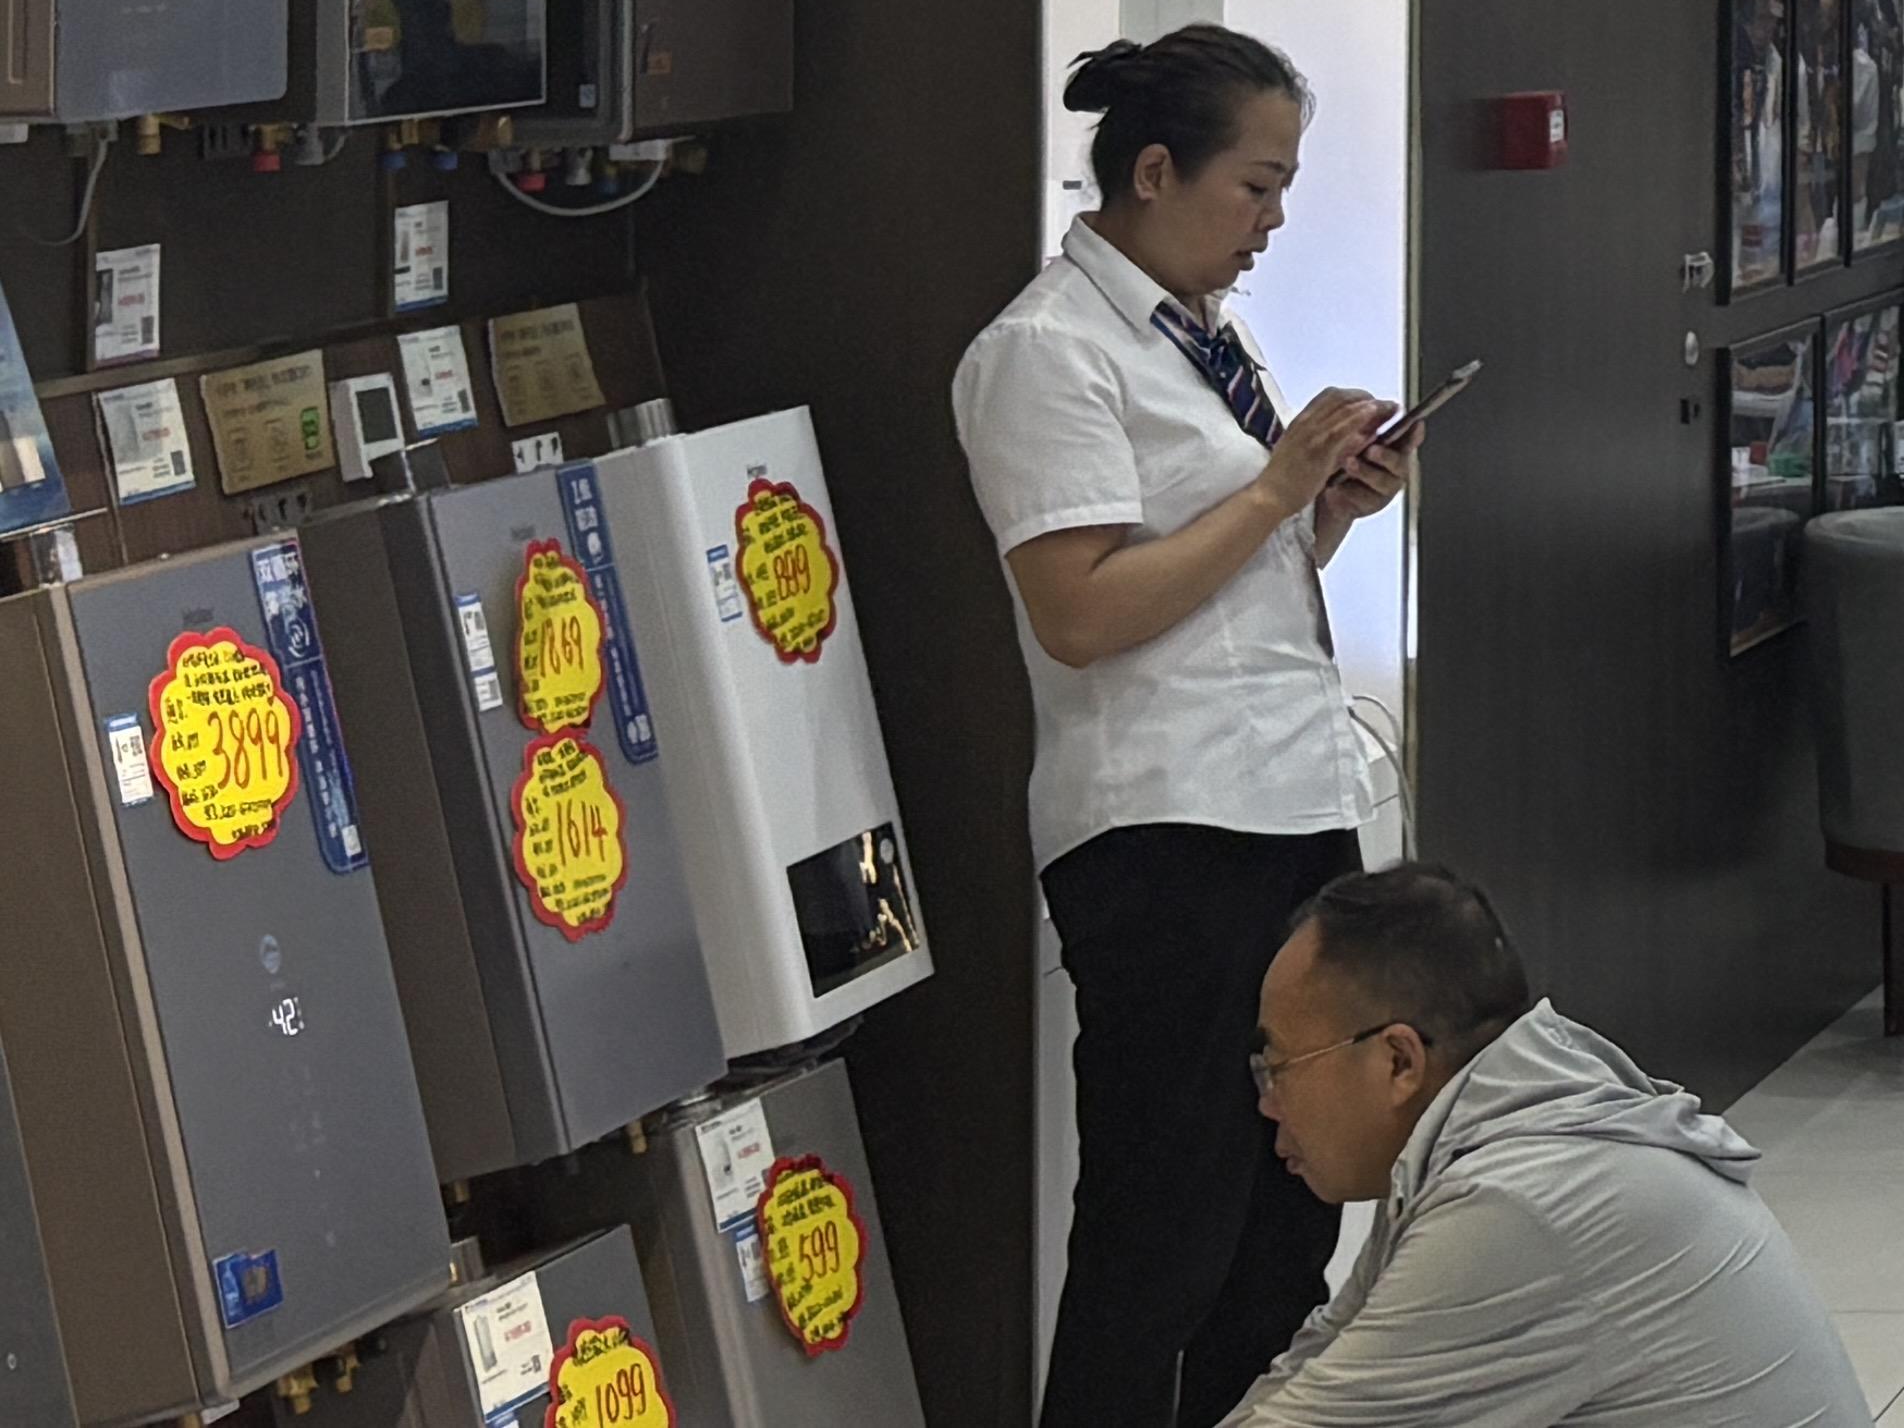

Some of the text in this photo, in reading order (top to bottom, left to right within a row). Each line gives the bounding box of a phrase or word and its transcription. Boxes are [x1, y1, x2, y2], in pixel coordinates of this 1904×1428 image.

[207, 707, 284, 790] 3899
[554, 798, 608, 867] 1614
[799, 1220, 840, 1283] 599
[595, 1362, 647, 1428] 1099
